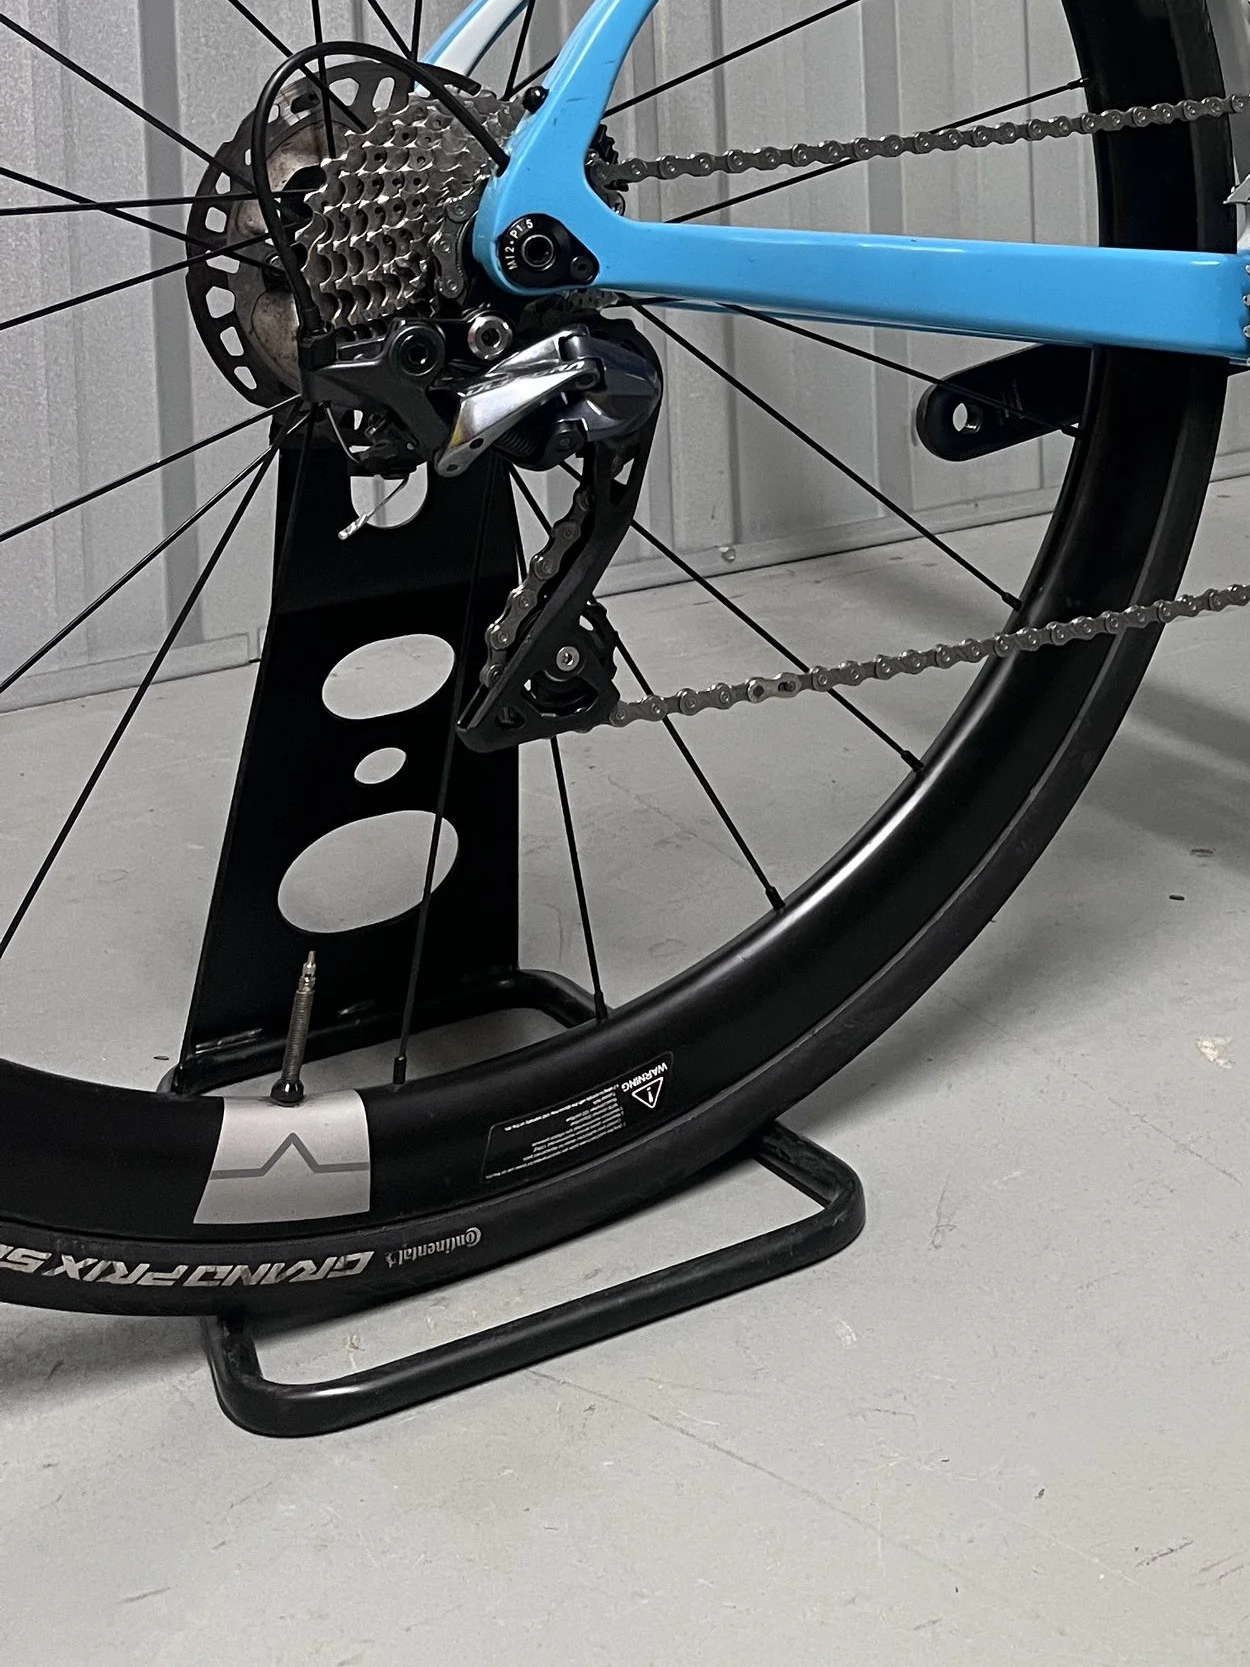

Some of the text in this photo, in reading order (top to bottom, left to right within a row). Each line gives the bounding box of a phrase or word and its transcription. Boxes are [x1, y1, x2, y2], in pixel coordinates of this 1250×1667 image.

[621, 1062, 668, 1093] WARNING
[0, 1243, 375, 1287] GRAND PRIX 5
[398, 1226, 481, 1265] Continental
